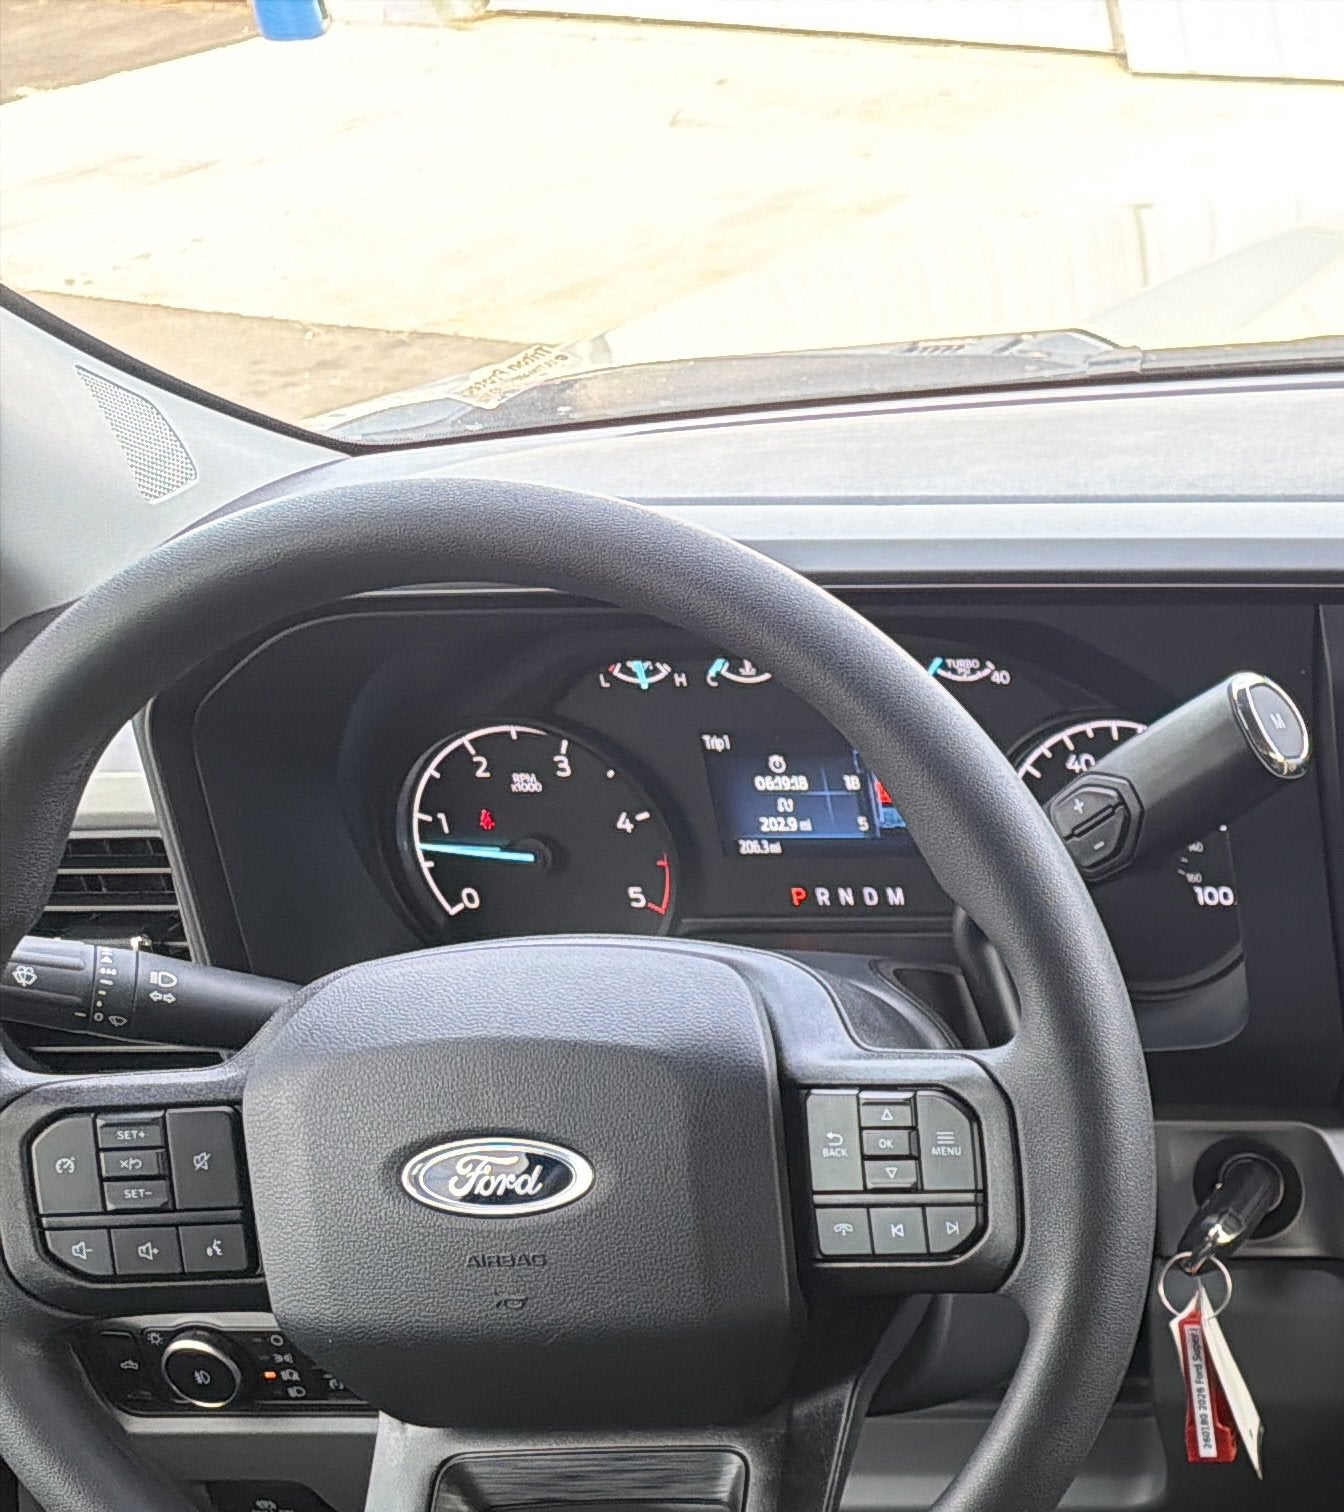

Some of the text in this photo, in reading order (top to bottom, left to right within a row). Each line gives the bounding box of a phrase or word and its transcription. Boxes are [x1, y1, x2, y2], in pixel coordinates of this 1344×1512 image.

[945, 658, 980, 669] TURBO
[673, 672, 688, 687] H
[990, 670, 1011, 685] 40
[472, 756, 491, 778] 2
[552, 755, 572, 778] 3
[511, 772, 536, 783] RPM
[437, 812, 450, 835] 1
[616, 811, 635, 834] 4
[461, 888, 480, 909] 0
[627, 886, 647, 909] 5
[790, 887, 905, 906] P R N D M
[1193, 885, 1235, 906] 100
[116, 1130, 146, 1140] SET+
[878, 1138, 894, 1149] OK
[822, 1147, 848, 1157] BACK
[931, 1146, 962, 1157] MENU
[449, 1154, 543, 1197] Ford
[465, 1253, 548, 1269] AIRBAG
